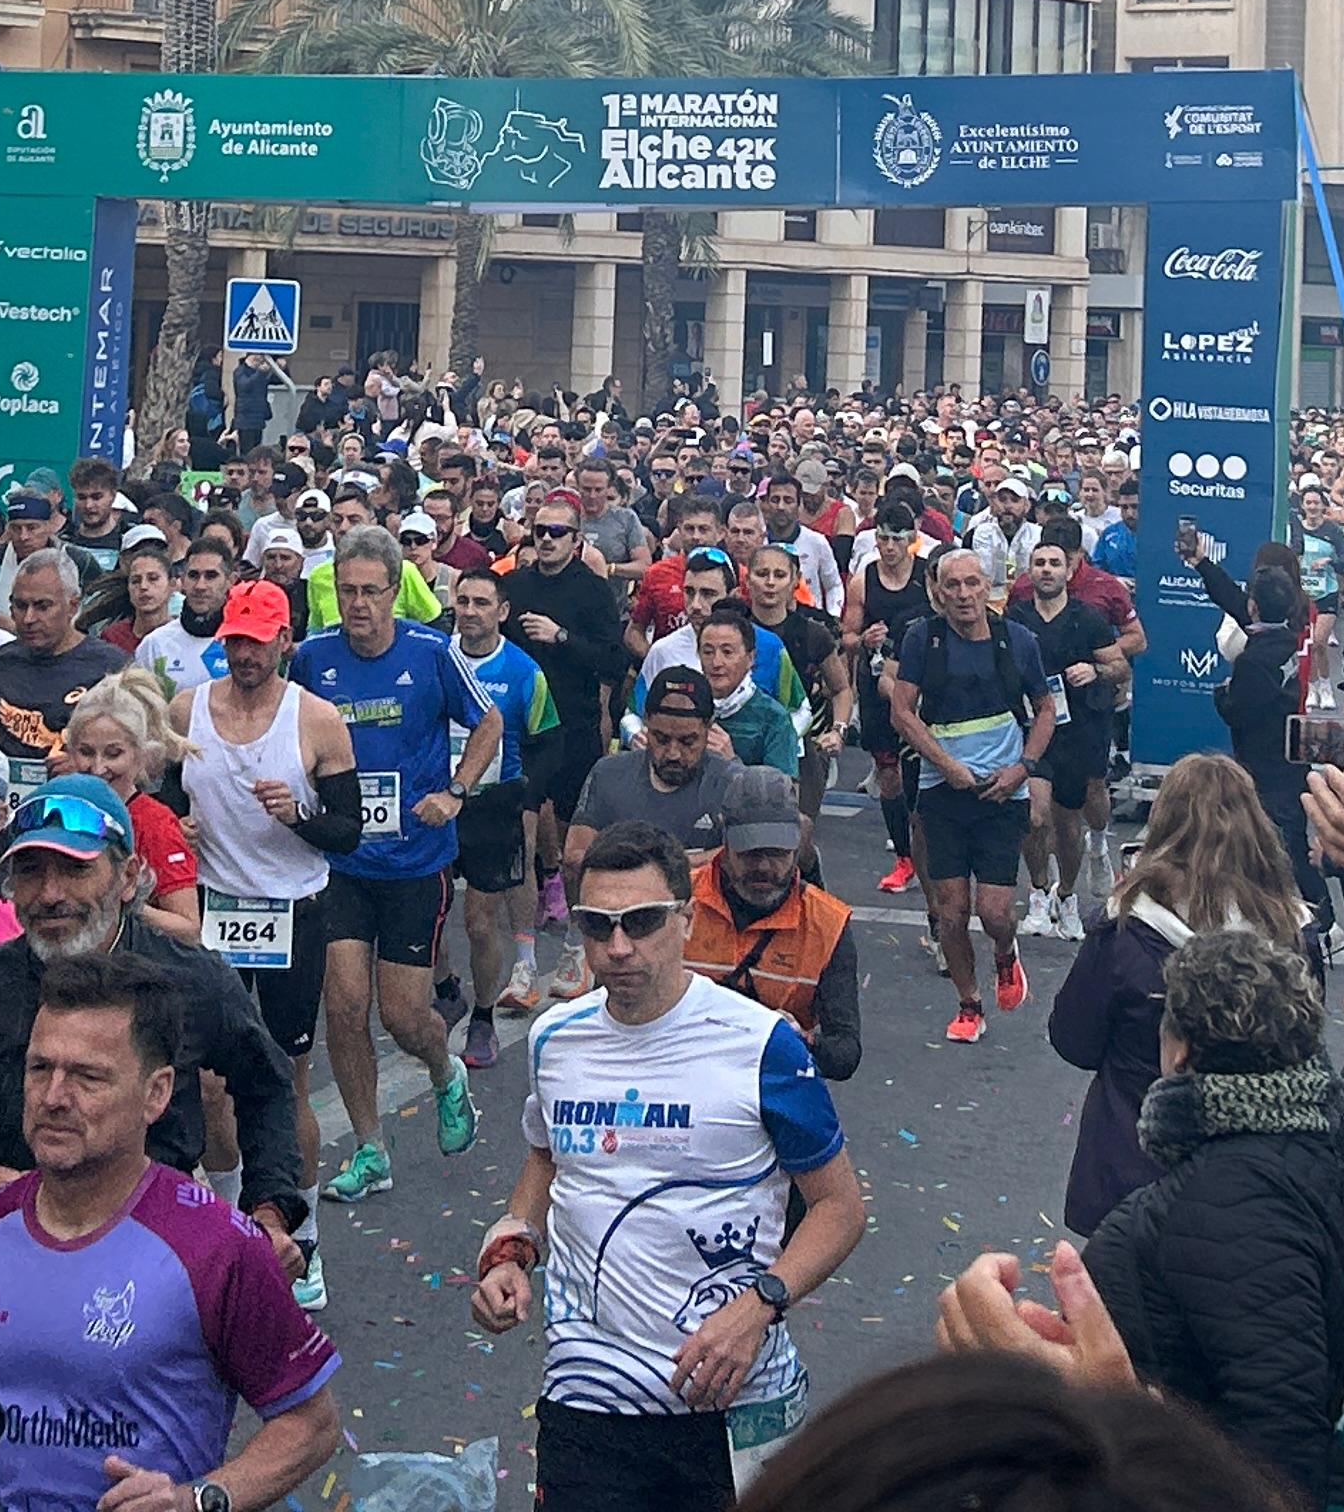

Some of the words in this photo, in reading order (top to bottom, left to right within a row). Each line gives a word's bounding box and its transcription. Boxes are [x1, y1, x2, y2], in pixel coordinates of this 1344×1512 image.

[602, 94, 637, 127] 1ª
[641, 88, 778, 114] MARATÓN
[209, 119, 333, 138] Ayuntamiento
[641, 115, 778, 127] INTERNACIONAL
[959, 123, 1070, 137] Excelentísimo
[222, 138, 244, 155] de
[247, 138, 318, 156] Alicante
[601, 129, 712, 160] Elche
[716, 138, 777, 160] 42K
[951, 140, 1079, 154] AYUNTAMIENTO
[599, 156, 777, 189] Alicante
[978, 156, 998, 169] de
[1001, 156, 1051, 169] ELCHE
[303, 212, 331, 232] DE
[340, 213, 455, 238] SEGUROS
[5, 246, 88, 261] vectalia
[1164, 246, 1264, 281] Coca-Cola
[89, 267, 115, 459] NTEMAR
[1173, 402, 1197, 420] HLA
[1169, 479, 1246, 499] Securitas
[218, 920, 277, 943] 1264
[553, 1092, 692, 1129] IRONMAN
[6, 1403, 141, 1450] OrthoMedic
